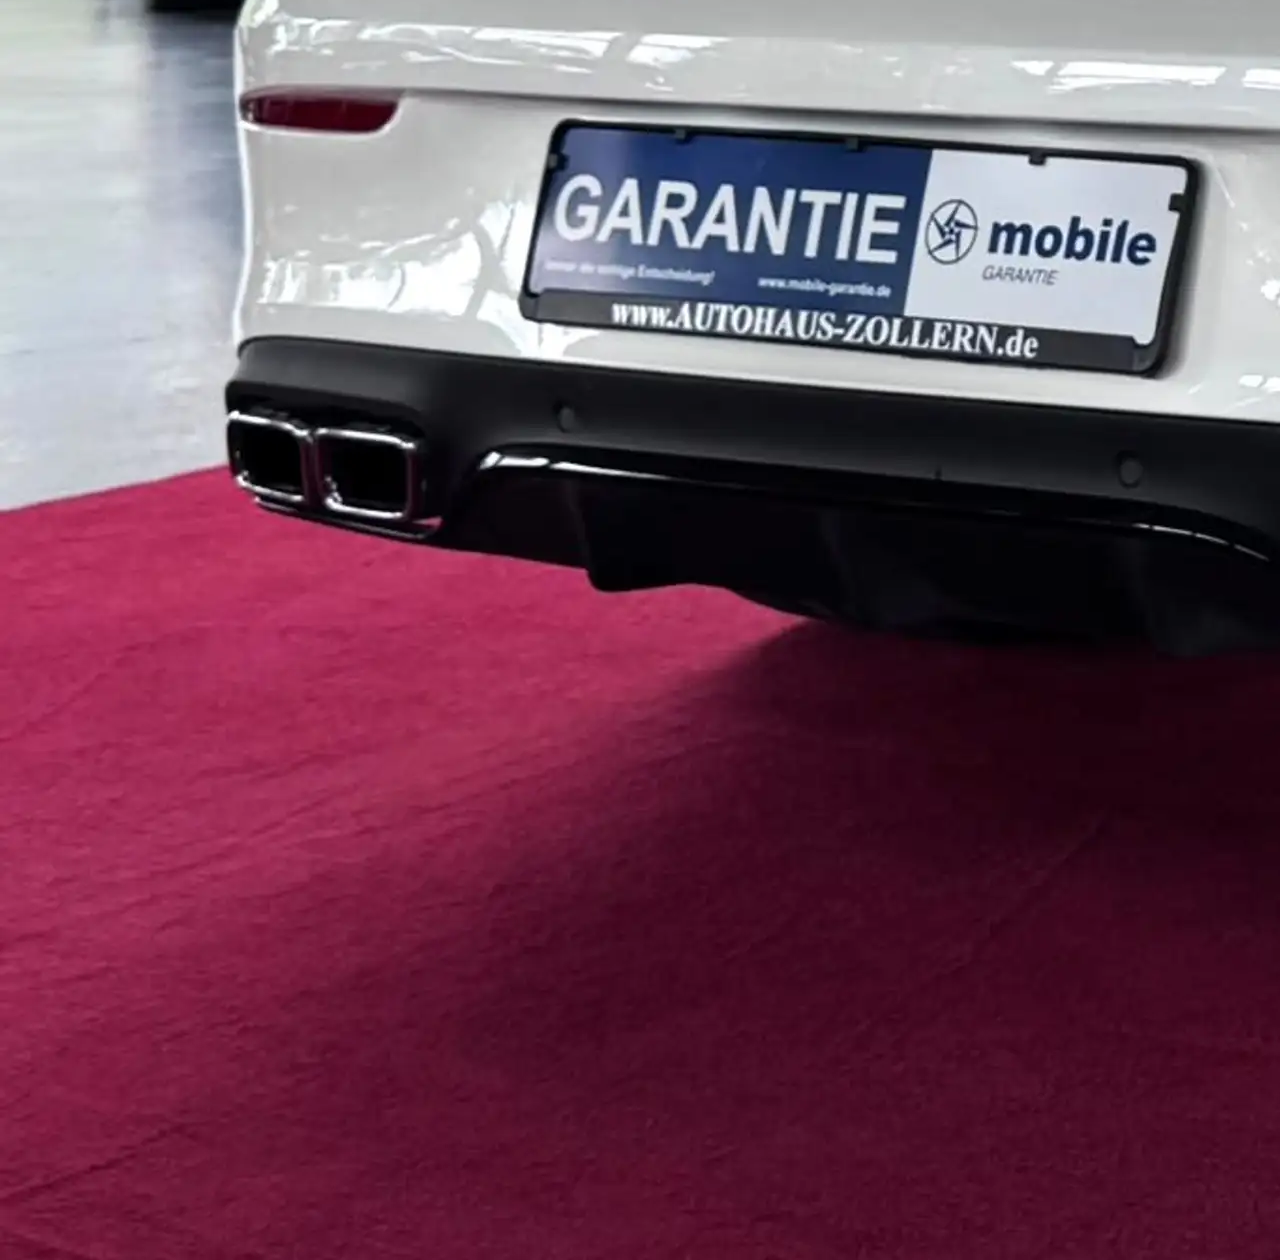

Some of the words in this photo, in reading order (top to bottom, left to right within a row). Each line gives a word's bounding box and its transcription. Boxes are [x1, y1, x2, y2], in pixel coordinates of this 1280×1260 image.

[553, 173, 907, 264] GARANTIE
[987, 216, 1158, 267] mobile
[757, 276, 892, 298] www.mobile-garantie.de
[982, 264, 1060, 287] GARANTIE
[610, 300, 1039, 359] www.AUTOHAUS-ZOLLERN.de
